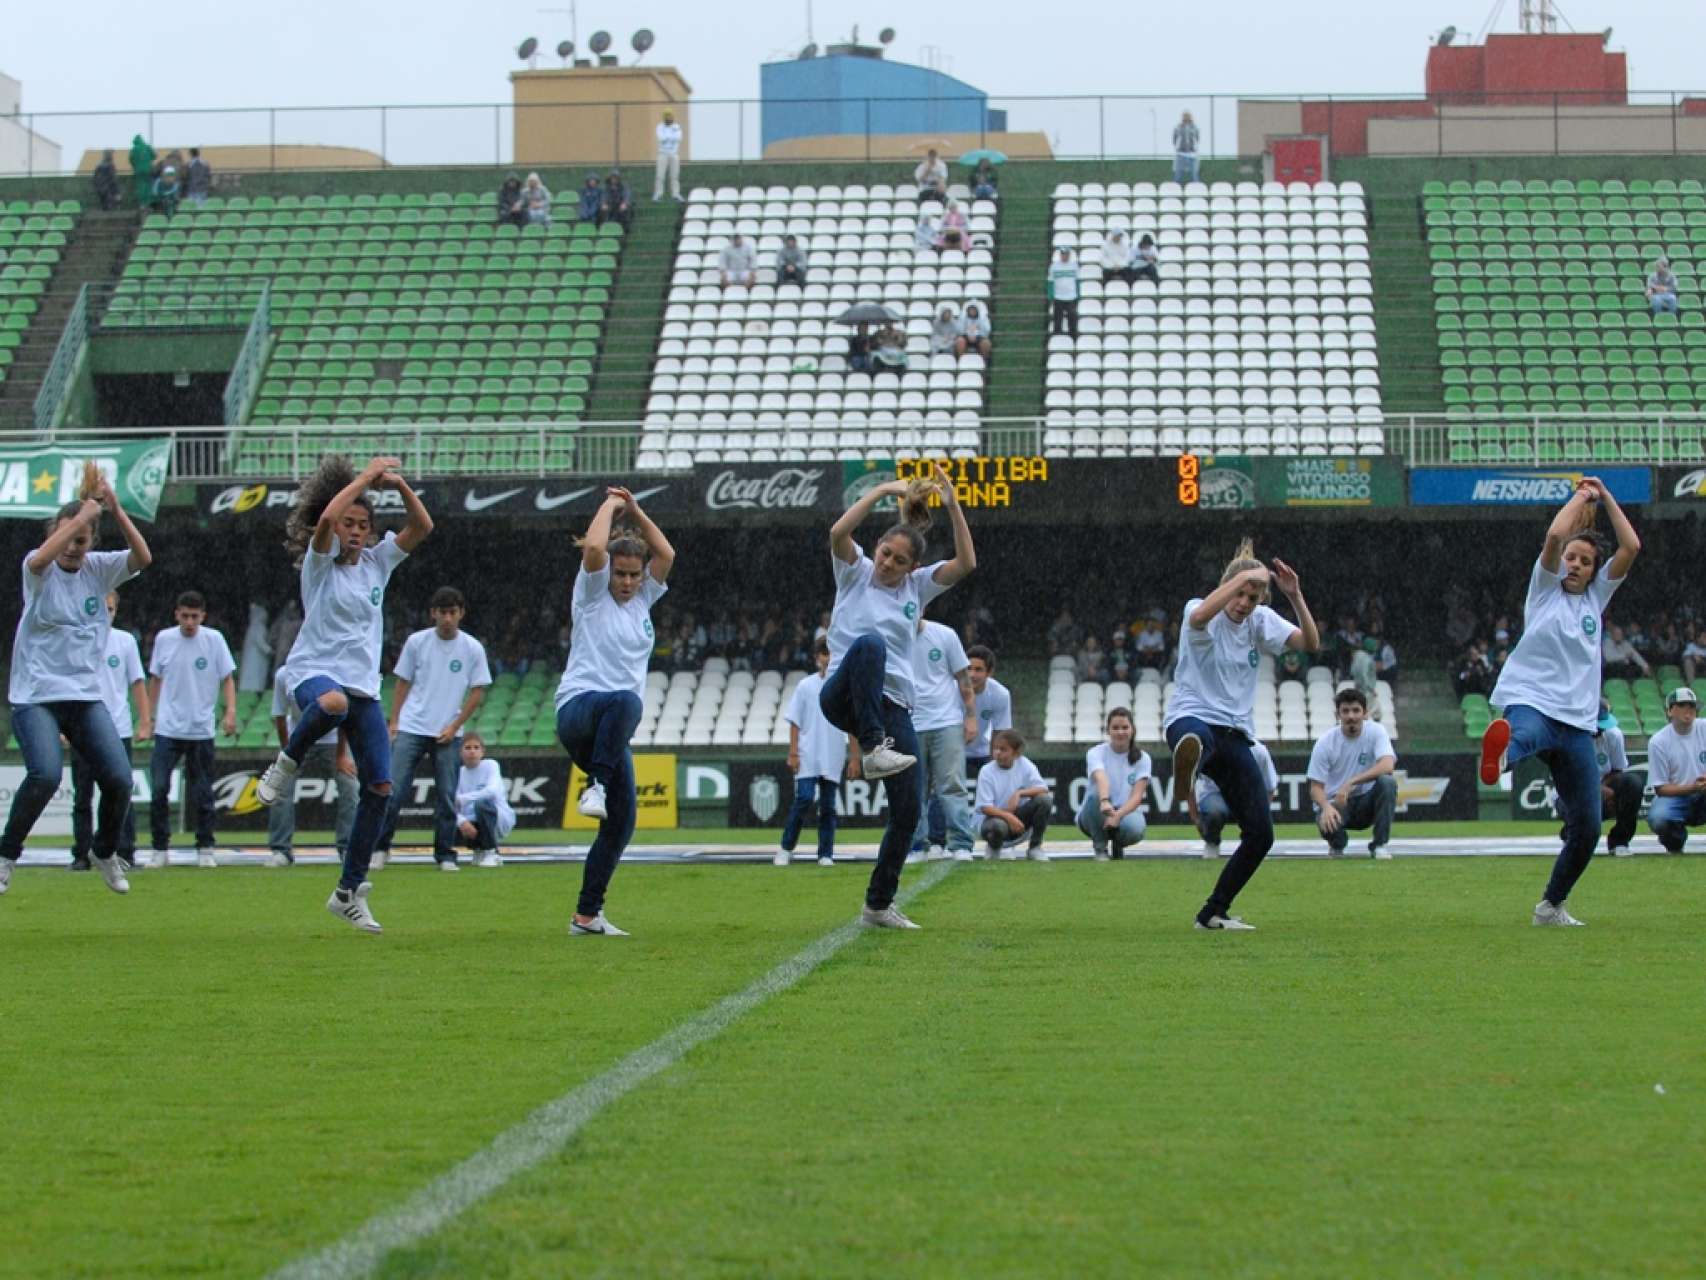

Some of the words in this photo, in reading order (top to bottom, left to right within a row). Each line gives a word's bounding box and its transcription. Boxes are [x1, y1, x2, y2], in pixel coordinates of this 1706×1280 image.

[896, 456, 1048, 481] CORITIBA
[1296, 460, 1334, 471] MAIS
[1288, 472, 1371, 485] VITORIOSO
[706, 468, 825, 510] Coca-Cola
[1300, 485, 1371, 499] MUNDO
[1471, 479, 1571, 501] NETSHOES
